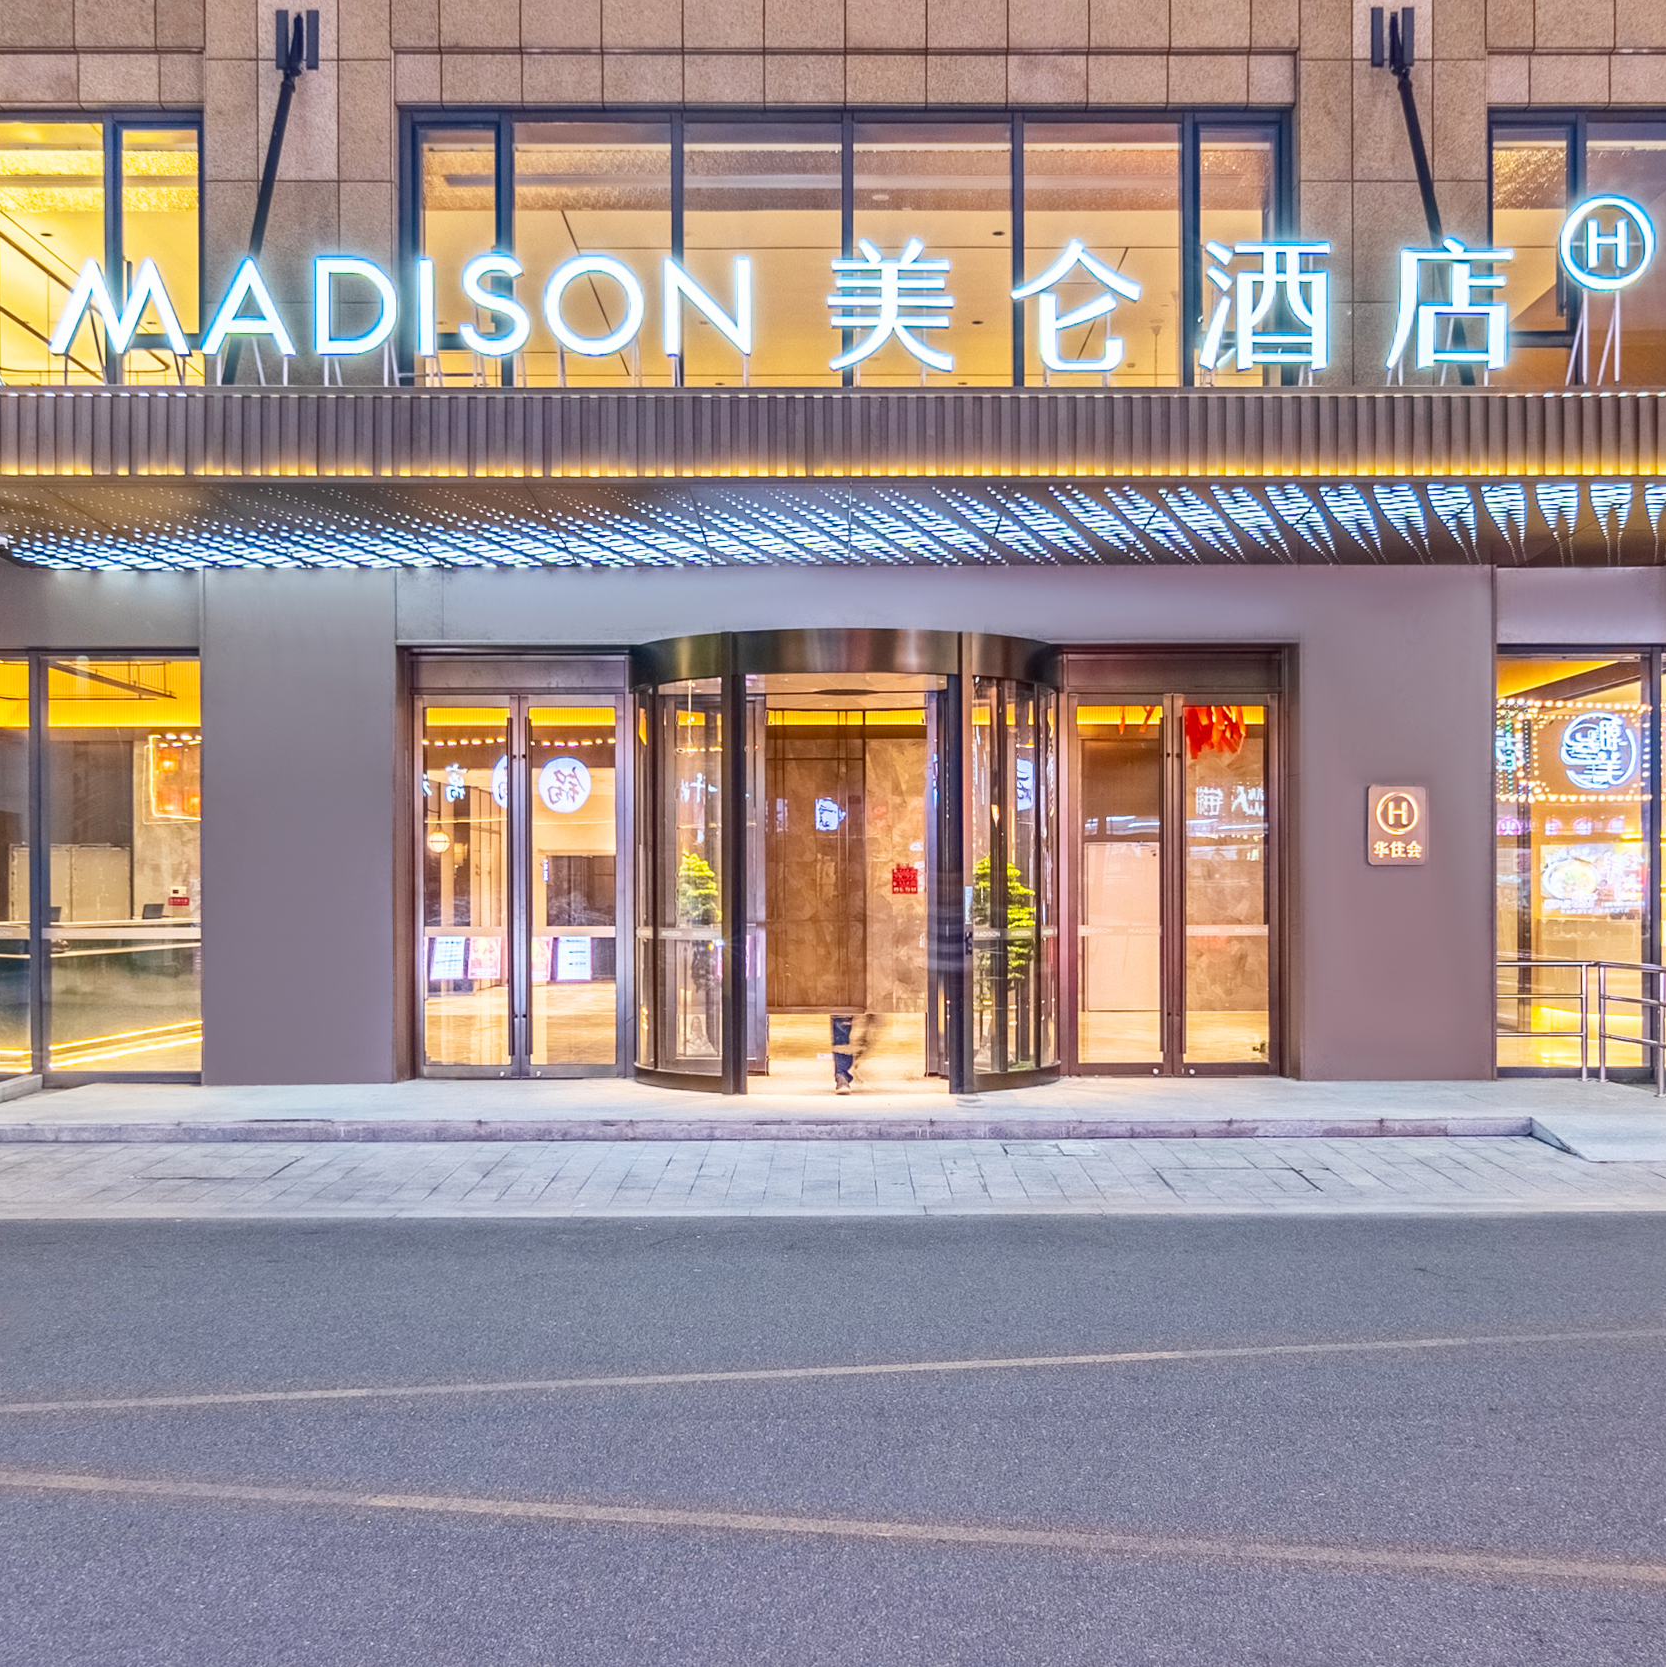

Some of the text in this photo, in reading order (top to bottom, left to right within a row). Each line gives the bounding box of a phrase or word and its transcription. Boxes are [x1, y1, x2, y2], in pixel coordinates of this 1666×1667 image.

[49, 236, 1515, 373] MADISON 美仑酒店
[1373, 840, 1423, 859] 华住会
